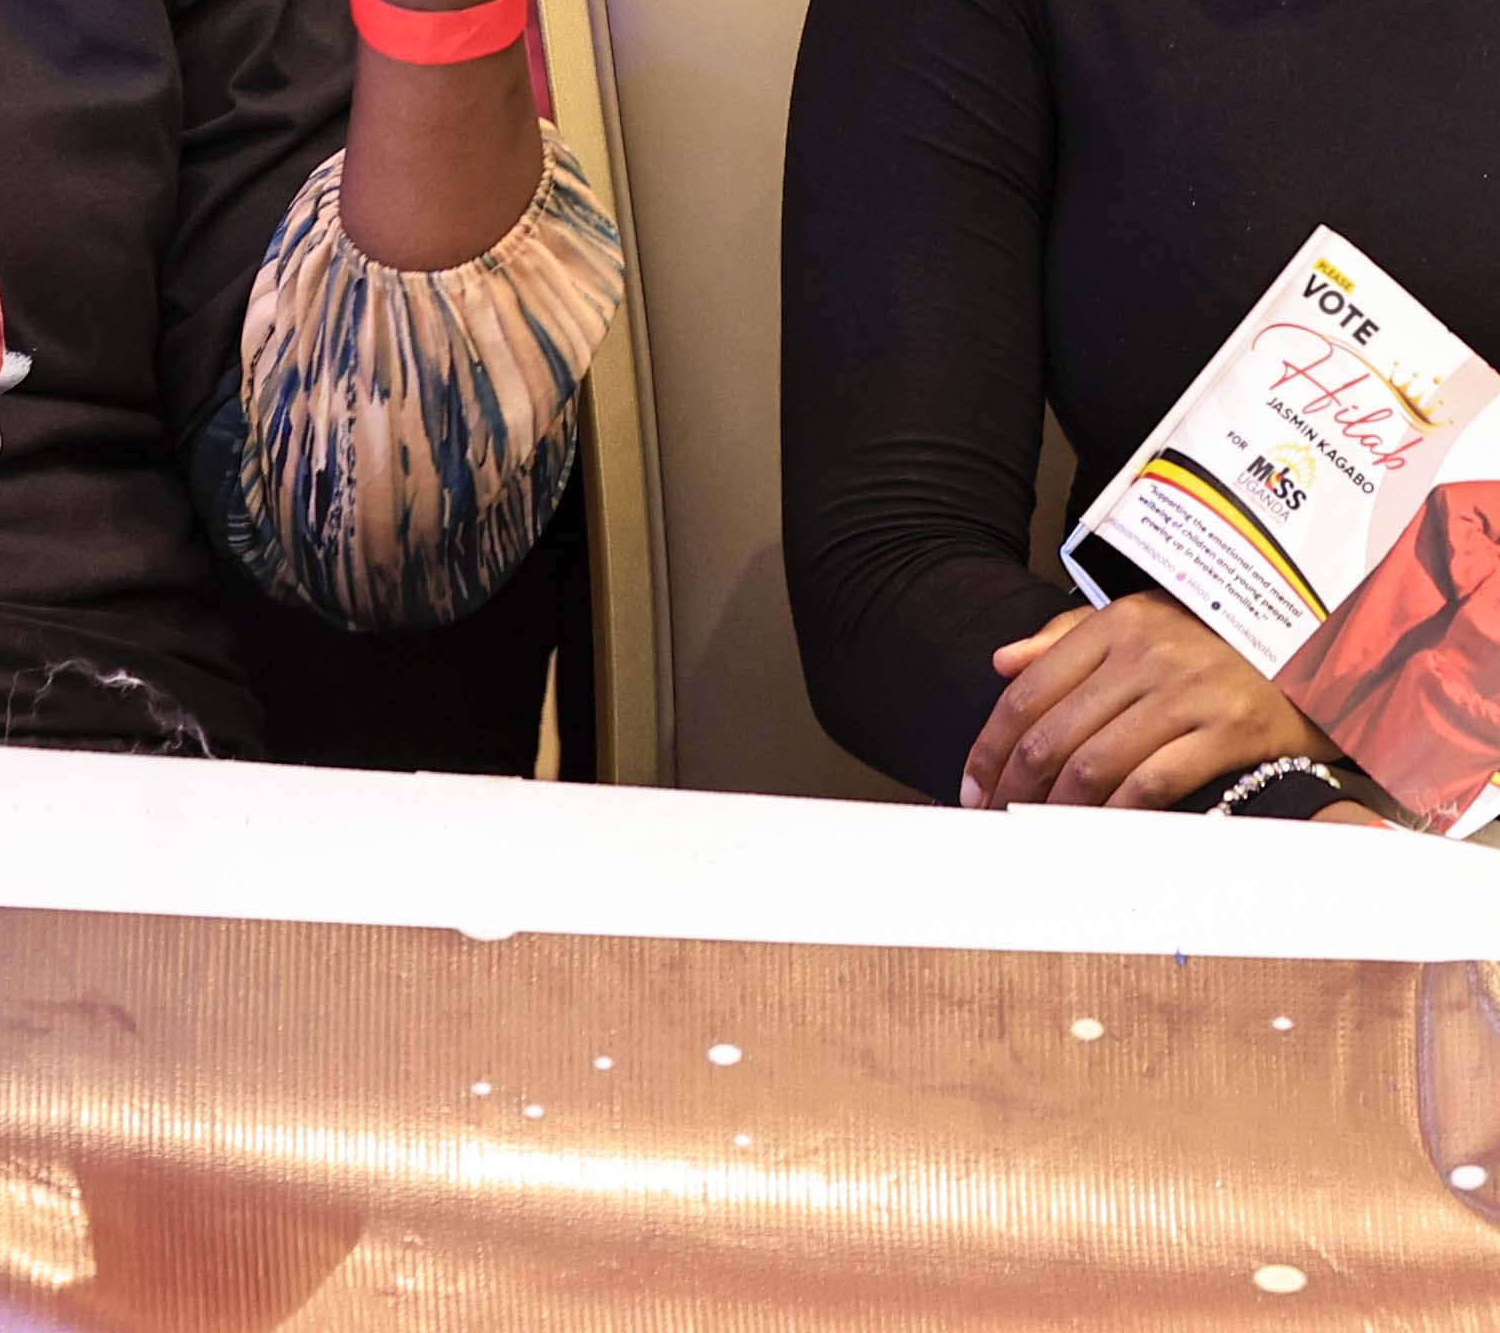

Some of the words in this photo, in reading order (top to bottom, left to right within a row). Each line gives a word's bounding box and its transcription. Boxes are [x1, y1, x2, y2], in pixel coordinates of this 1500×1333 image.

[1302, 274, 1380, 346] VOTE
[1226, 430, 1249, 451] FOR
[1266, 397, 1319, 442] JASMIN
[1316, 437, 1375, 494] KAGABO
[1237, 472, 1291, 522] UGANDA
[1193, 554, 1225, 584] broken
[1208, 531, 1253, 572] emotional
[1260, 597, 1293, 629] people
